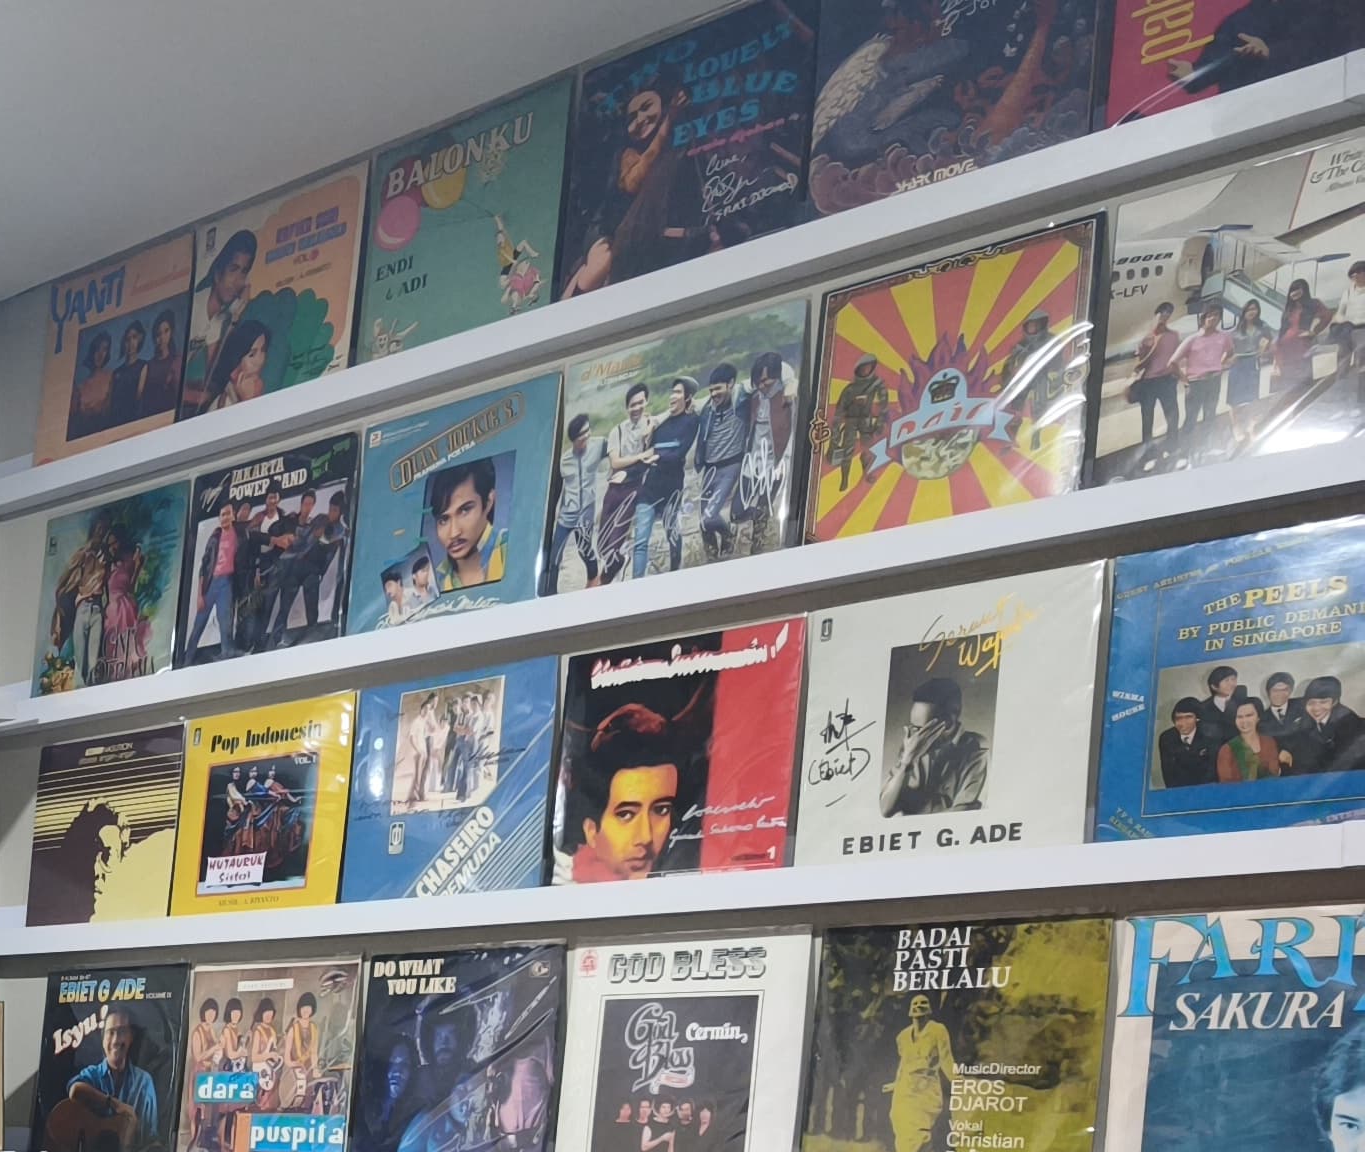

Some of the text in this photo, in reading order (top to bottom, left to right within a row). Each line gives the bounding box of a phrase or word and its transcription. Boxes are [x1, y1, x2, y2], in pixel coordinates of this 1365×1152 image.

[692, 70, 798, 104] BLUE
[672, 99, 760, 146] EYES
[385, 112, 534, 200] BALONKU
[933, 158, 976, 182] MOVE
[374, 256, 416, 283] ENDI
[399, 273, 427, 300] ADI
[231, 457, 284, 485] JAKARTA
[400, 442, 439, 486] DIAN
[1203, 575, 1349, 616] THE PEELS
[1178, 624, 1201, 641] BY
[1207, 614, 1275, 636] PUBLIC
[1204, 620, 1342, 652] IN SINGAPORE
[211, 734, 239, 755] Pop
[416, 806, 494, 898] CHASEIRO
[842, 822, 1023, 856] EBIET G. ADE
[209, 856, 264, 870] HUTAURUK
[896, 926, 972, 952] BADAI
[373, 958, 445, 978] DO WHAT
[610, 947, 767, 984] GOD BLESS
[895, 947, 970, 972] PASTI
[1116, 914, 1365, 1018] FARI
[58, 980, 98, 1004] EBIET
[97, 979, 111, 1002] G
[111, 977, 147, 1001] ADE
[387, 976, 457, 996] YOU LIKE
[892, 965, 1011, 993] BERLALU
[1169, 990, 1346, 1032] SAKURA
[53, 1004, 109, 1055] Isyu!
[685, 1022, 749, 1044] Cermin,
[952, 1062, 1042, 1077] MusicDirector
[198, 1077, 255, 1099] dara
[950, 1079, 1006, 1096] EROS
[948, 1095, 1028, 1113] DJAROT
[250, 1119, 345, 1150] puspita
[948, 1120, 984, 1133] Vokal
[945, 1131, 1025, 1150] Christian
